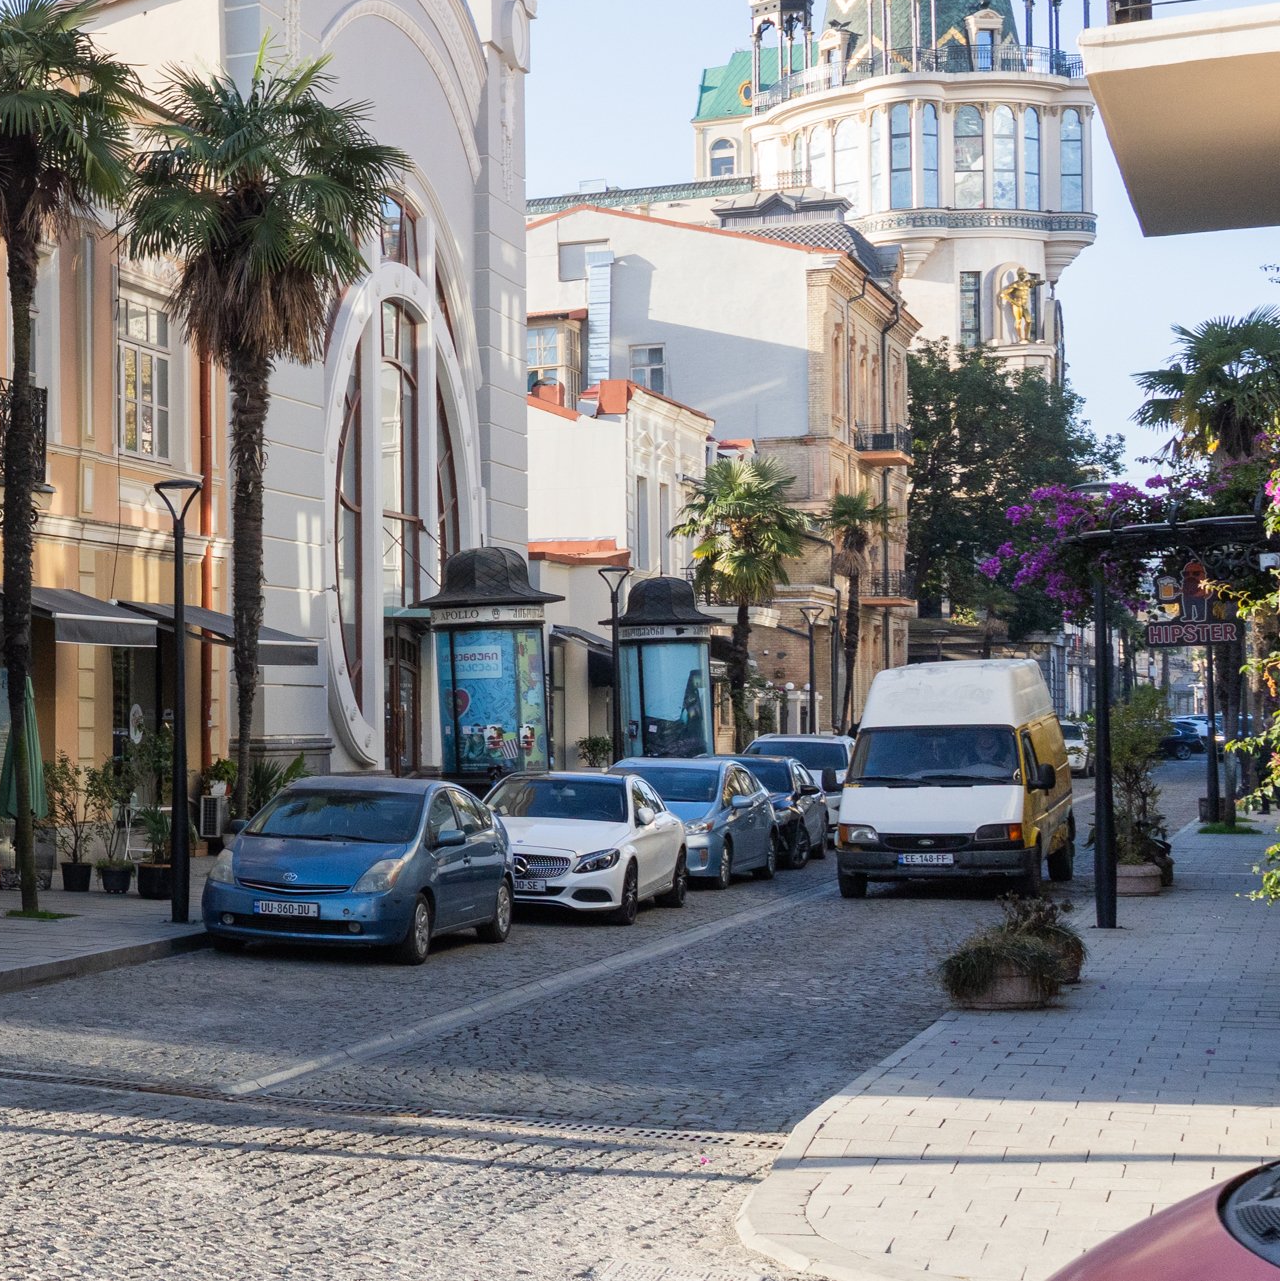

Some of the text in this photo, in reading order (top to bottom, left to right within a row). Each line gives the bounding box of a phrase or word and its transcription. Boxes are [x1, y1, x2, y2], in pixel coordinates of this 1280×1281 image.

[441, 609, 480, 620] APOLLO
[1148, 623, 1237, 644] HIPSTER
[261, 902, 310, 915] UU-860-DU
